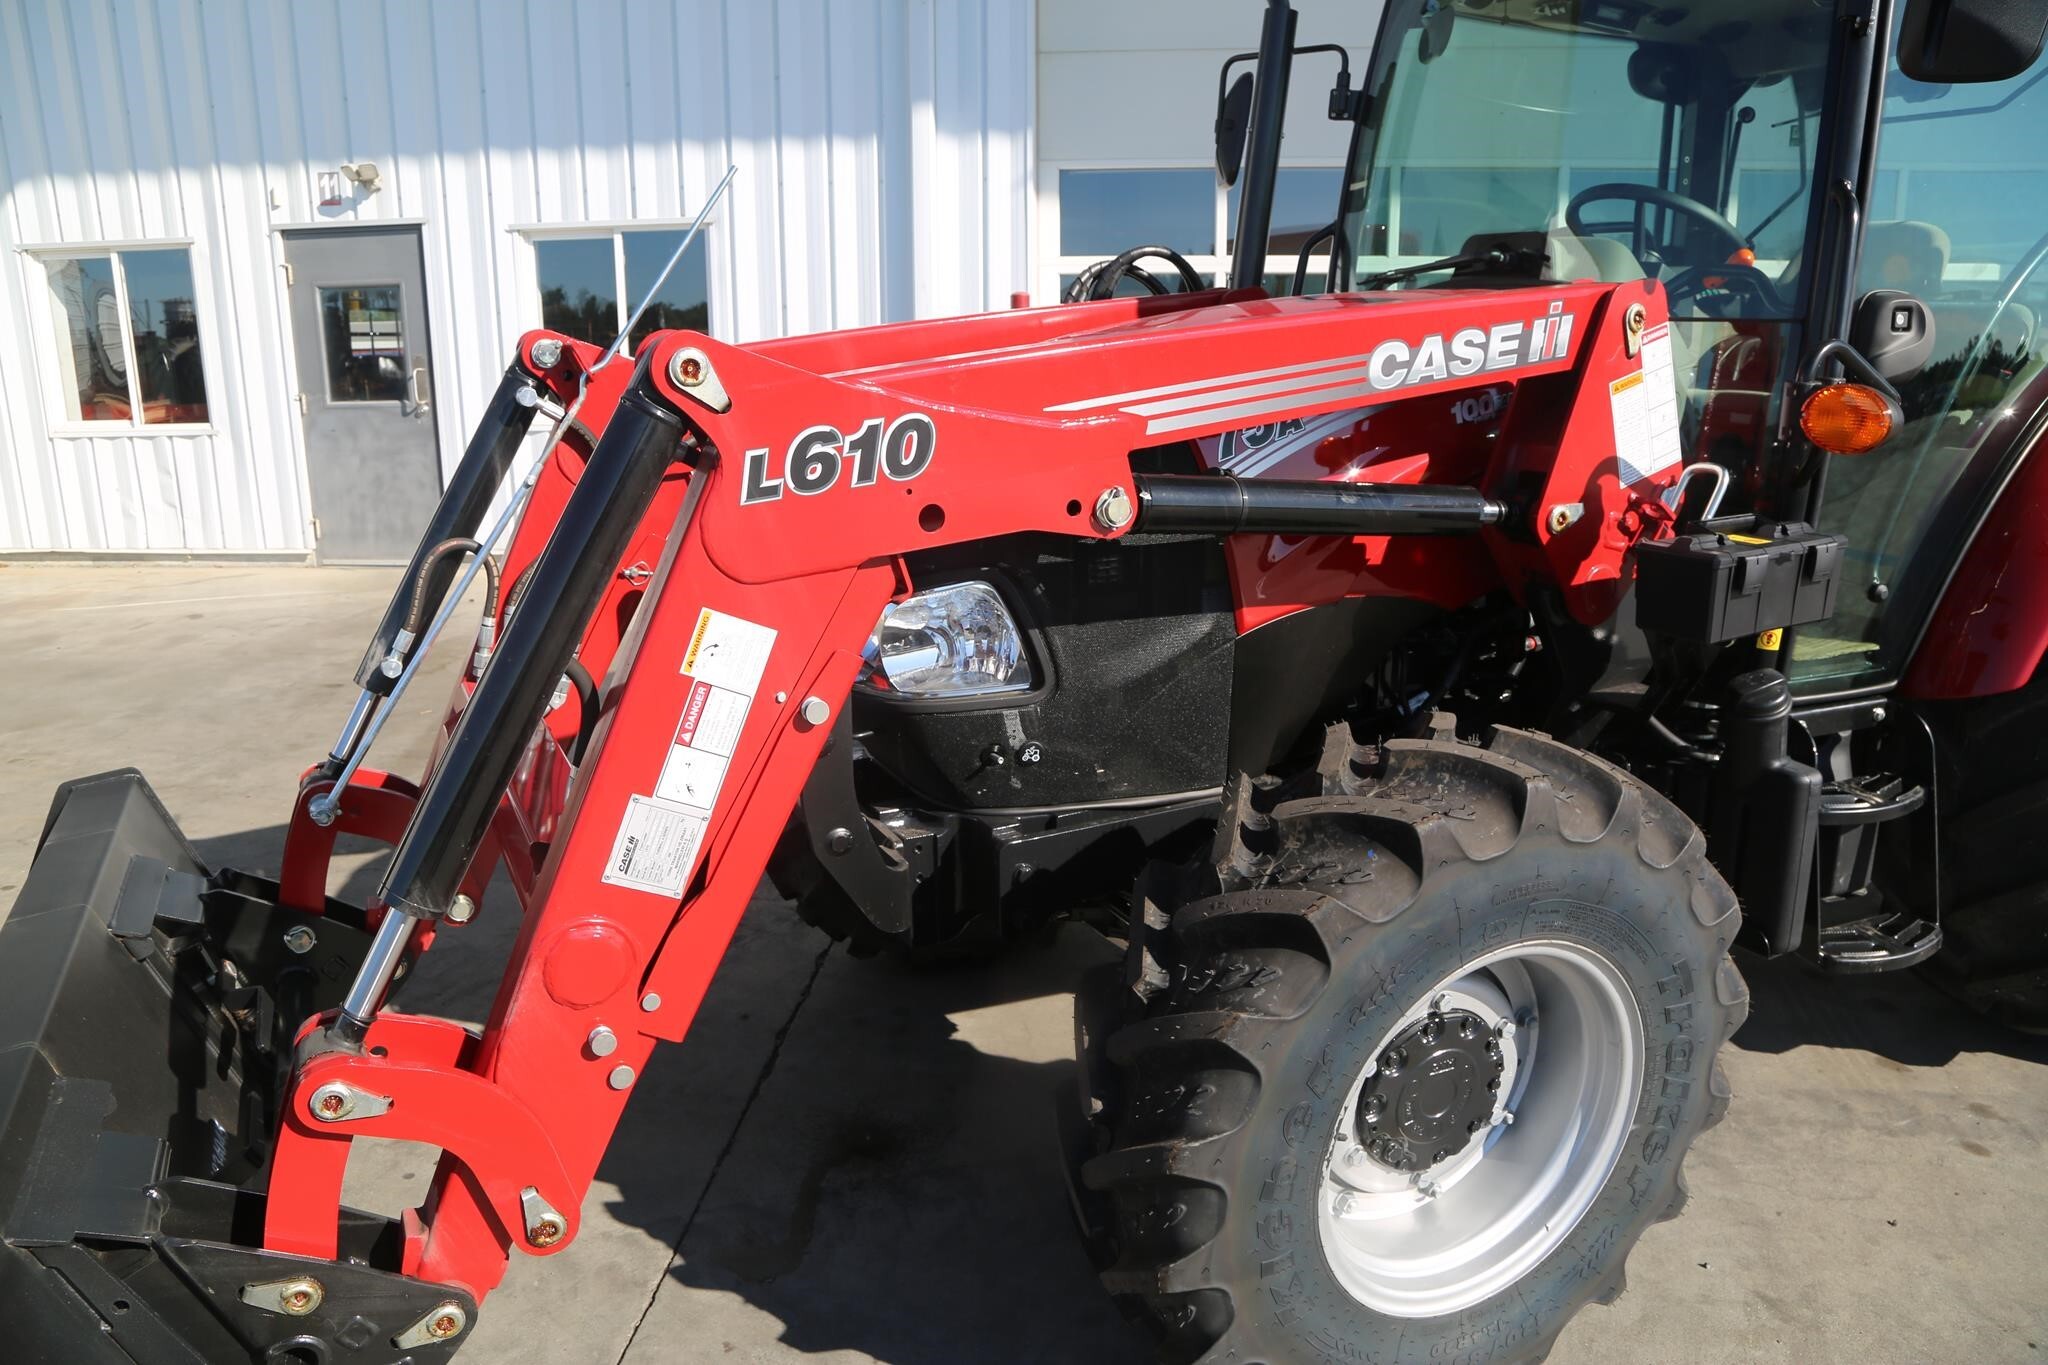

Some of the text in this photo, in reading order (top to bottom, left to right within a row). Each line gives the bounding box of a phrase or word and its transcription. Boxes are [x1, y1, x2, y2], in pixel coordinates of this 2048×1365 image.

[320, 174, 338, 200] 11
[1368, 322, 1524, 390] CASE
[739, 412, 937, 507] L610
[690, 615, 710, 657] WARNING
[684, 686, 707, 730] DANGER
[618, 845, 632, 872] CASE
